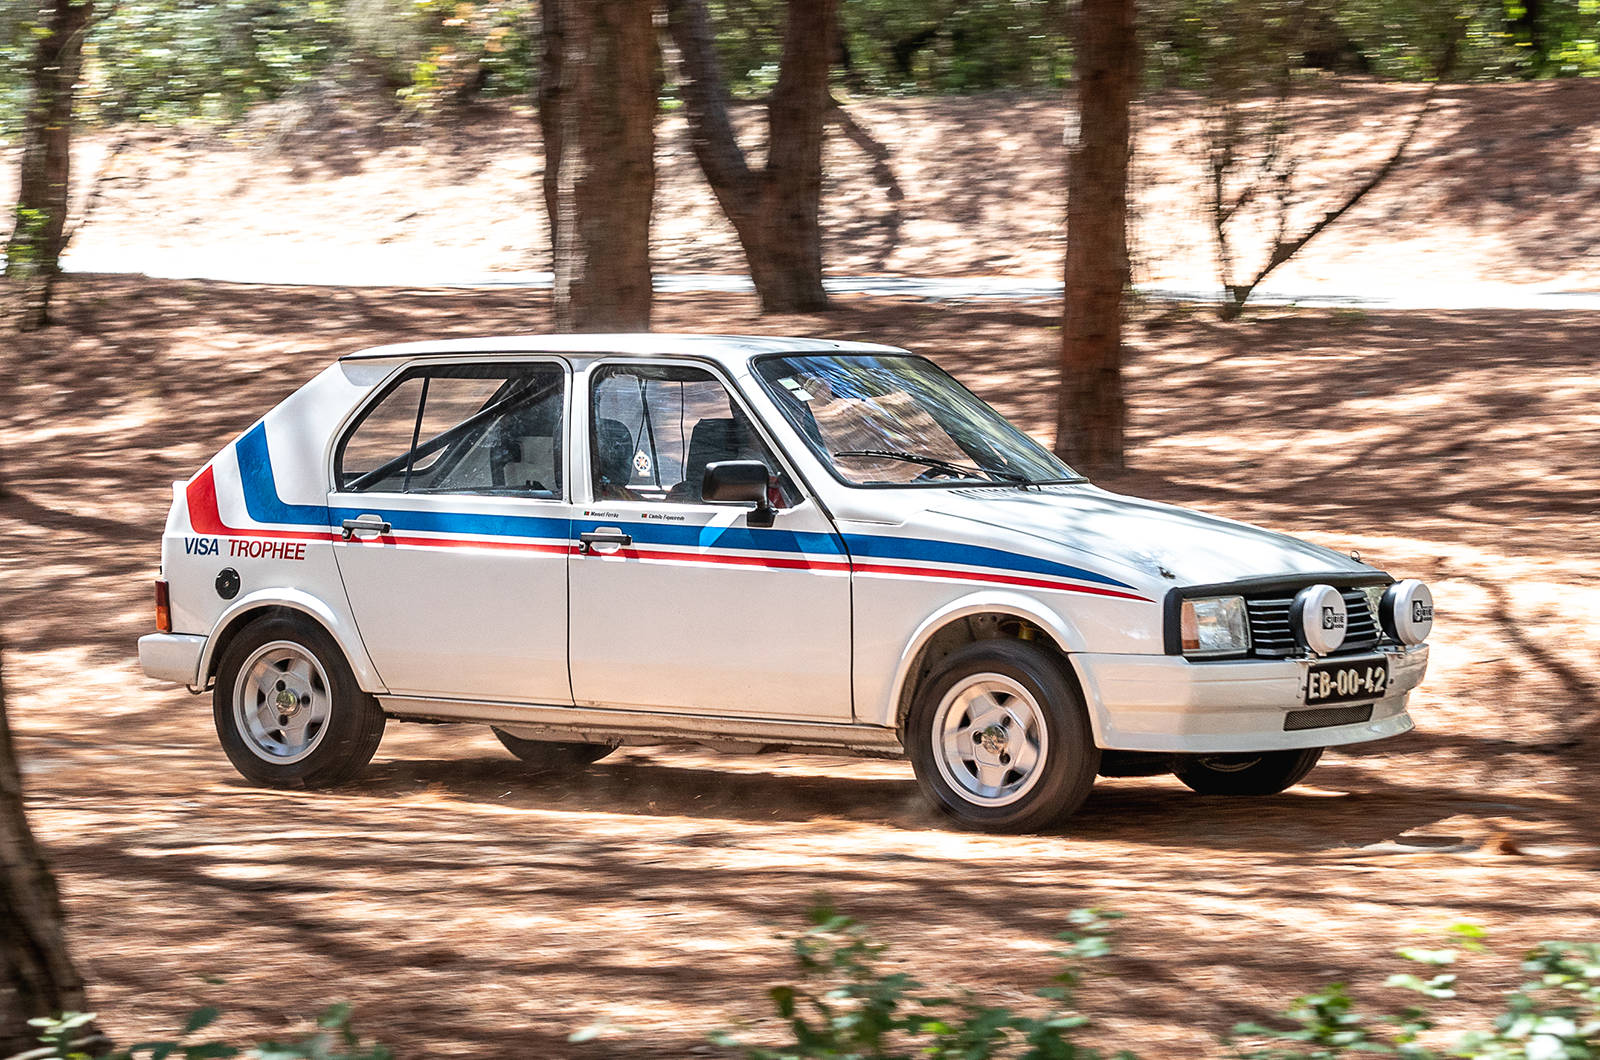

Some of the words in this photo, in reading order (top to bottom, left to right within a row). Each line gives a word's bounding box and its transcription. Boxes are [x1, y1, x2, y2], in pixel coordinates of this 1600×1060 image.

[184, 537, 219, 556] VISA
[228, 539, 307, 561] TROPHEE
[1308, 666, 1385, 699] EB-00-42
